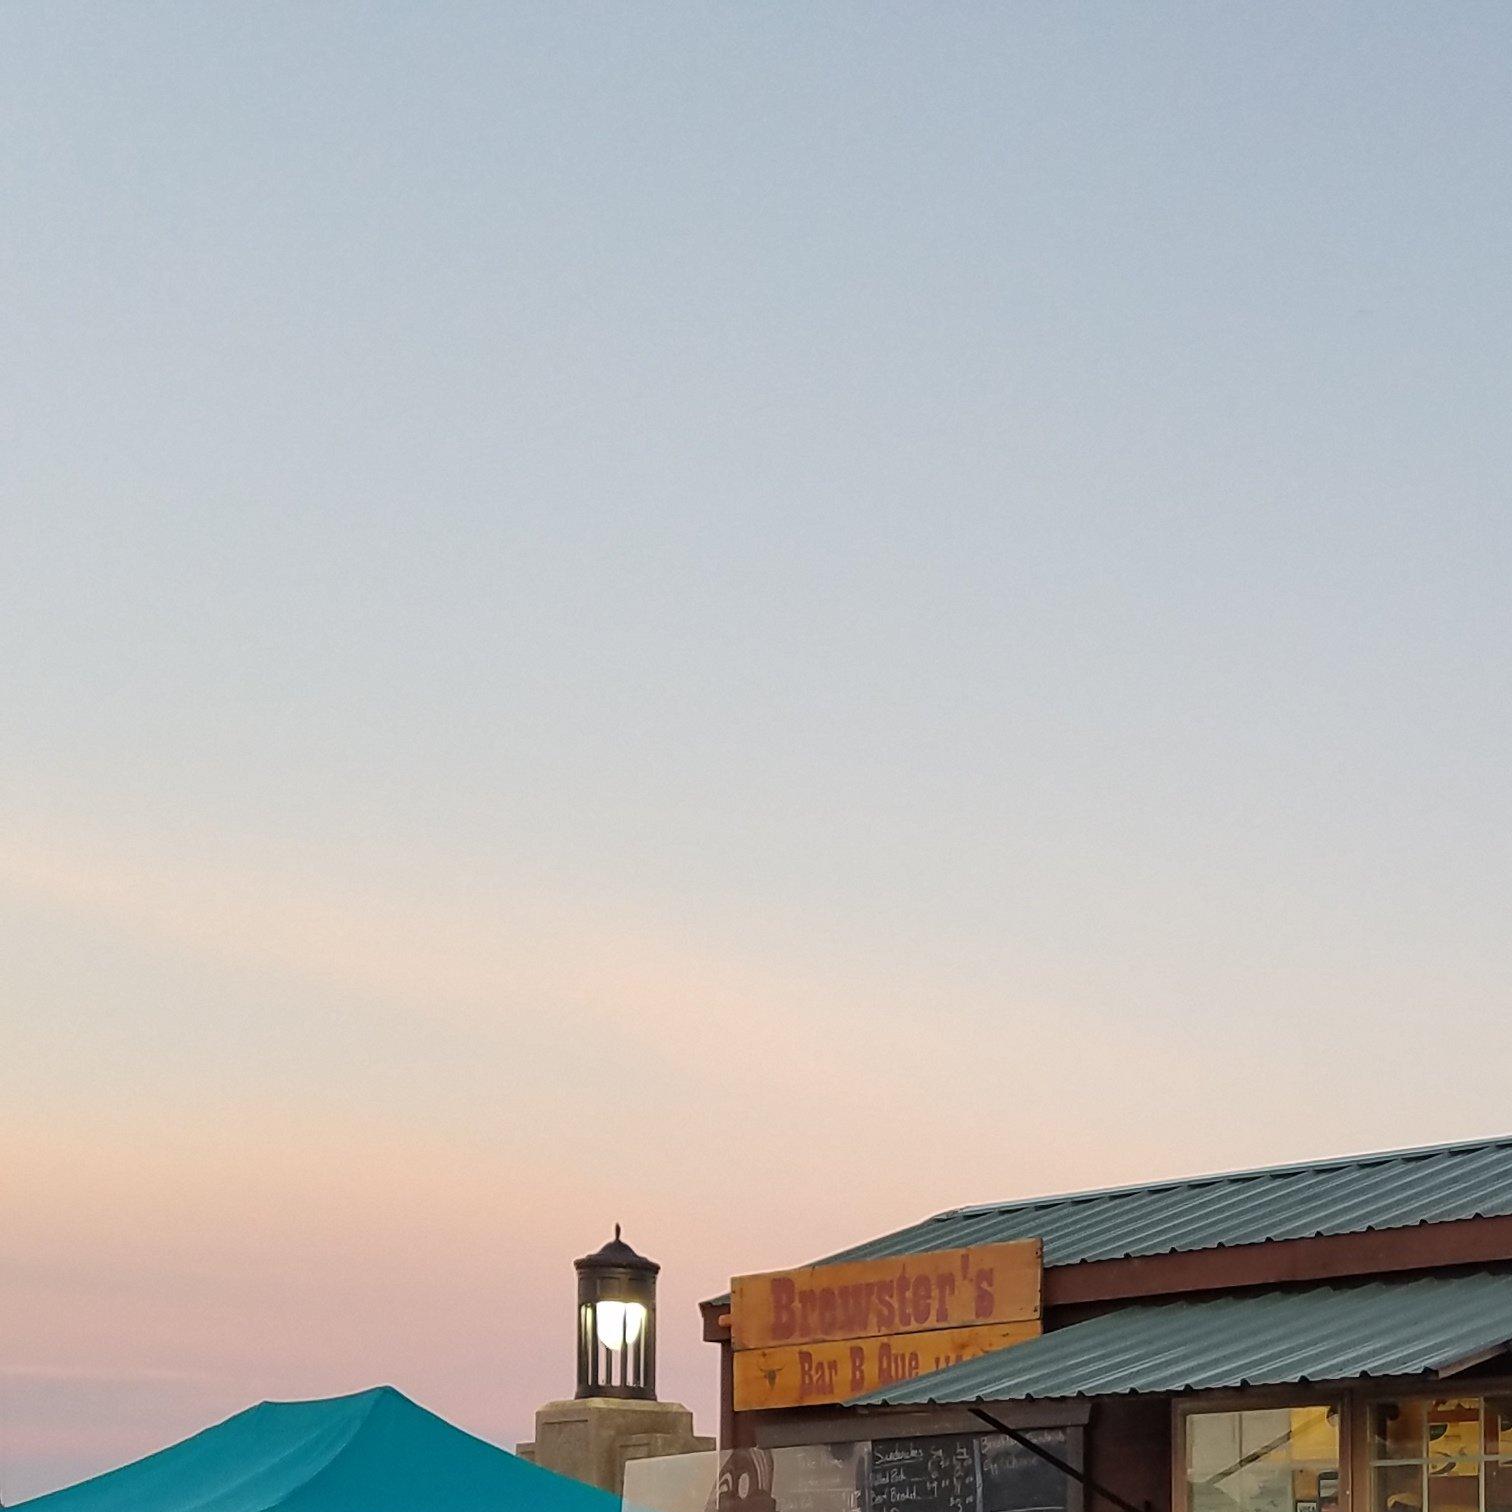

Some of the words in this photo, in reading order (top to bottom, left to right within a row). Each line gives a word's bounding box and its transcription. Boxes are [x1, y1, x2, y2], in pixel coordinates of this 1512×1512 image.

[771, 1253, 995, 1341] Brewster's
[798, 1350, 838, 1398] Bar
[849, 1345, 865, 1392] B
[878, 1341, 920, 1386] Que
